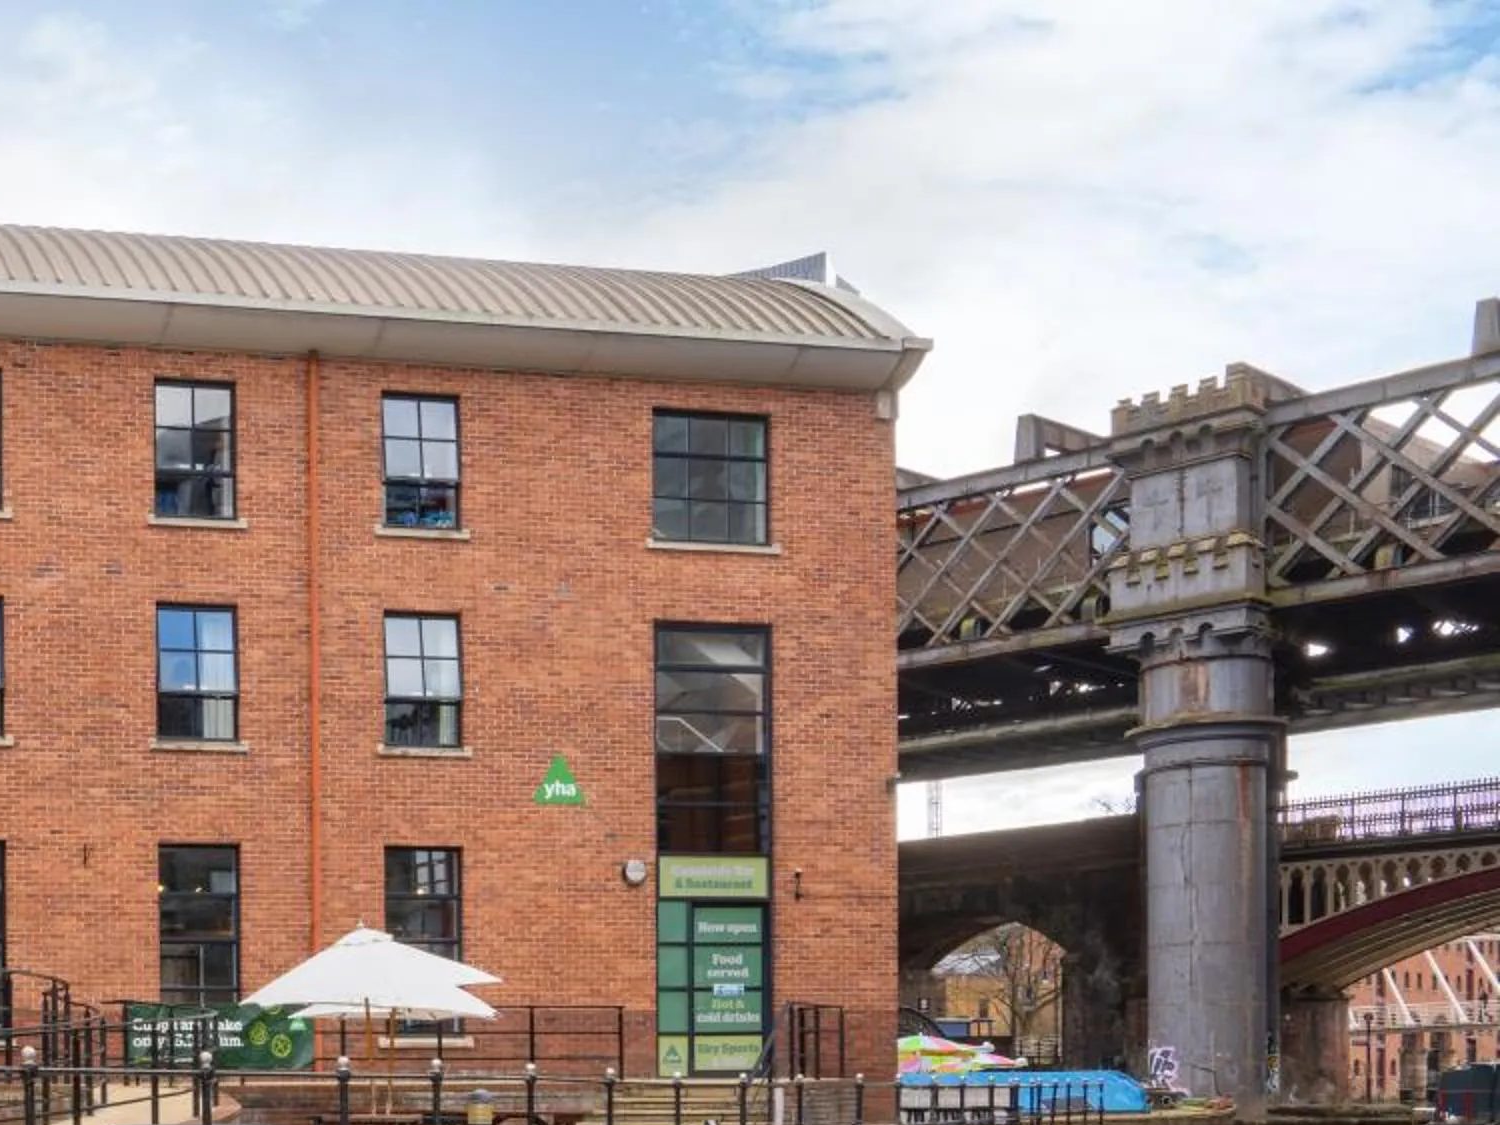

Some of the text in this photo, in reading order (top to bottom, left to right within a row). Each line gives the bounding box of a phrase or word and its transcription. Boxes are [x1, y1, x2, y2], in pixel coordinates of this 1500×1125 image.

[543, 779, 577, 800] yha
[698, 922, 757, 935] Now open
[712, 954, 743, 965] Food
[707, 967, 749, 978] served
[722, 1011, 760, 1022] drinks
[132, 1034, 165, 1050] ony
